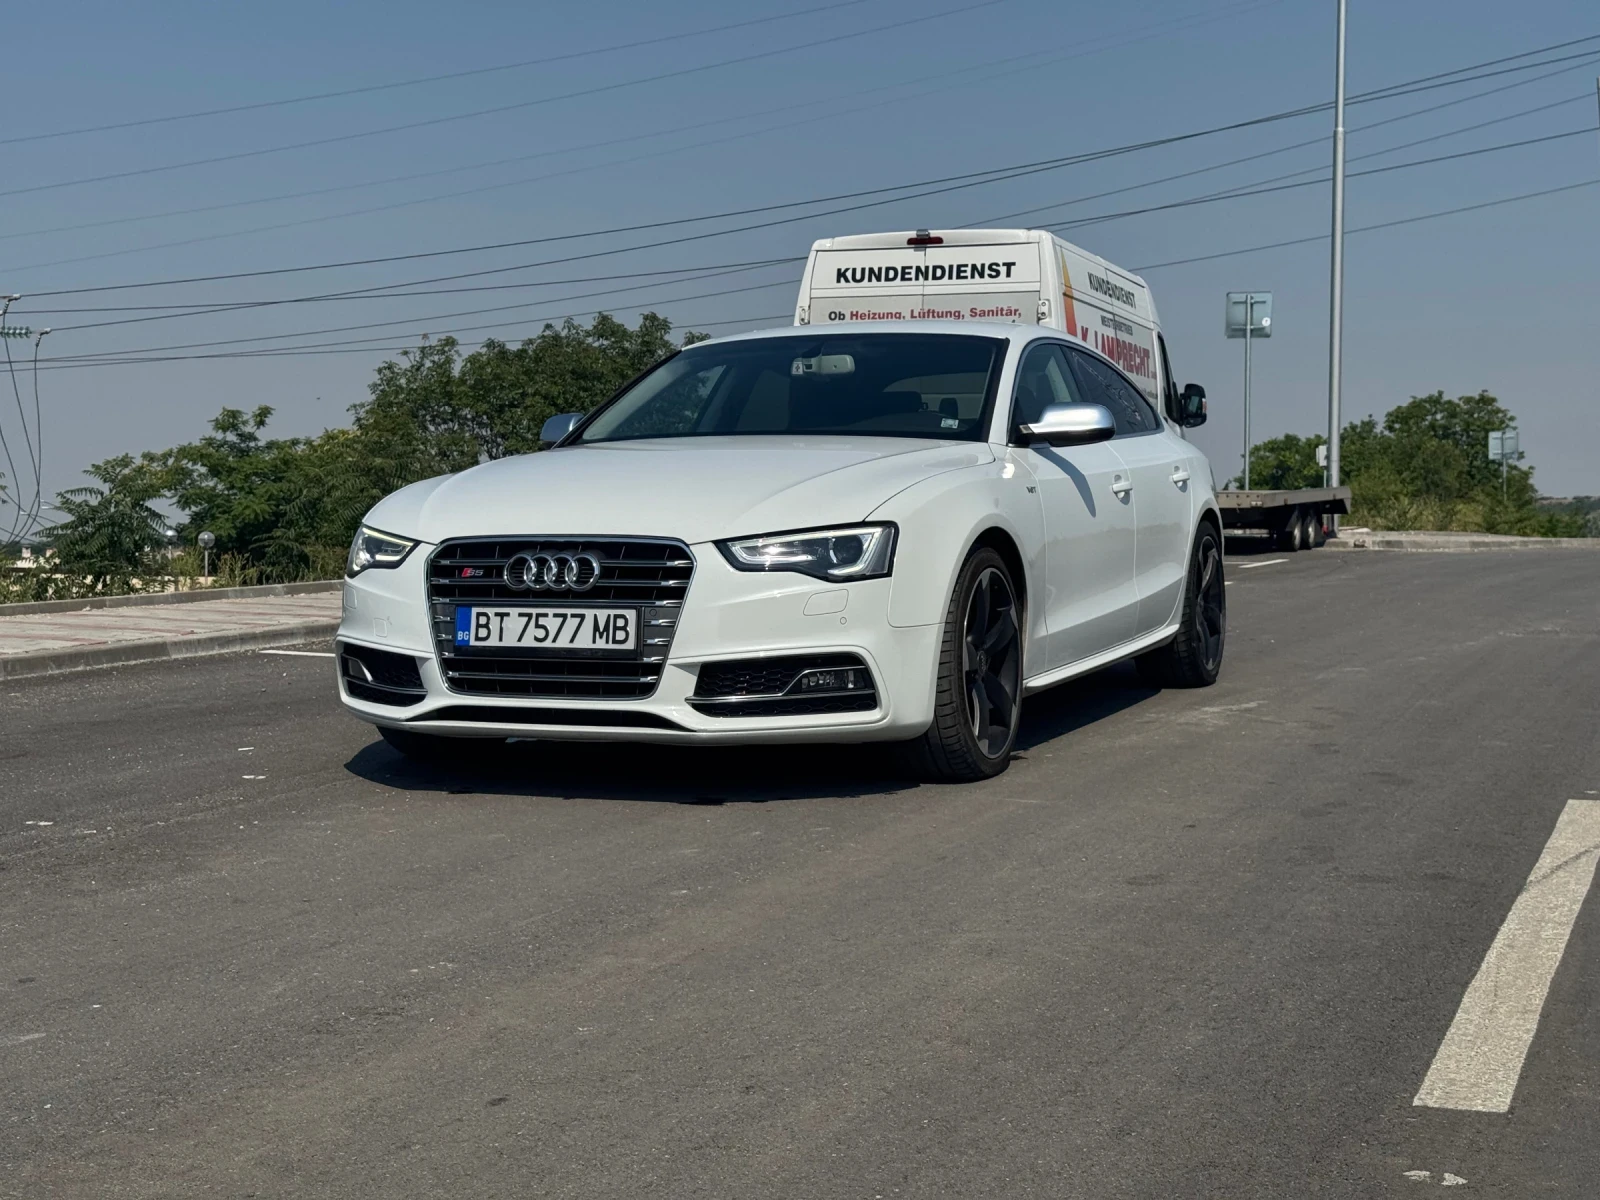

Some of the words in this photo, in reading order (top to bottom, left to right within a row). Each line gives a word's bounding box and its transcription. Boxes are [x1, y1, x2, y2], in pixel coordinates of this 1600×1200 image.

[835, 262, 1016, 284] KUNDENDIENST
[1087, 272, 1136, 309] KUNDENDIENST
[828, 310, 846, 321] Ob
[849, 310, 906, 321] Heizung,
[910, 308, 965, 320] Lüftung,
[969, 306, 1022, 319] Sanitär,
[464, 568, 485, 577] S5
[457, 631, 469, 641] BG
[474, 611, 510, 642] BT
[516, 612, 586, 644] 7577
[592, 613, 630, 645] MB
